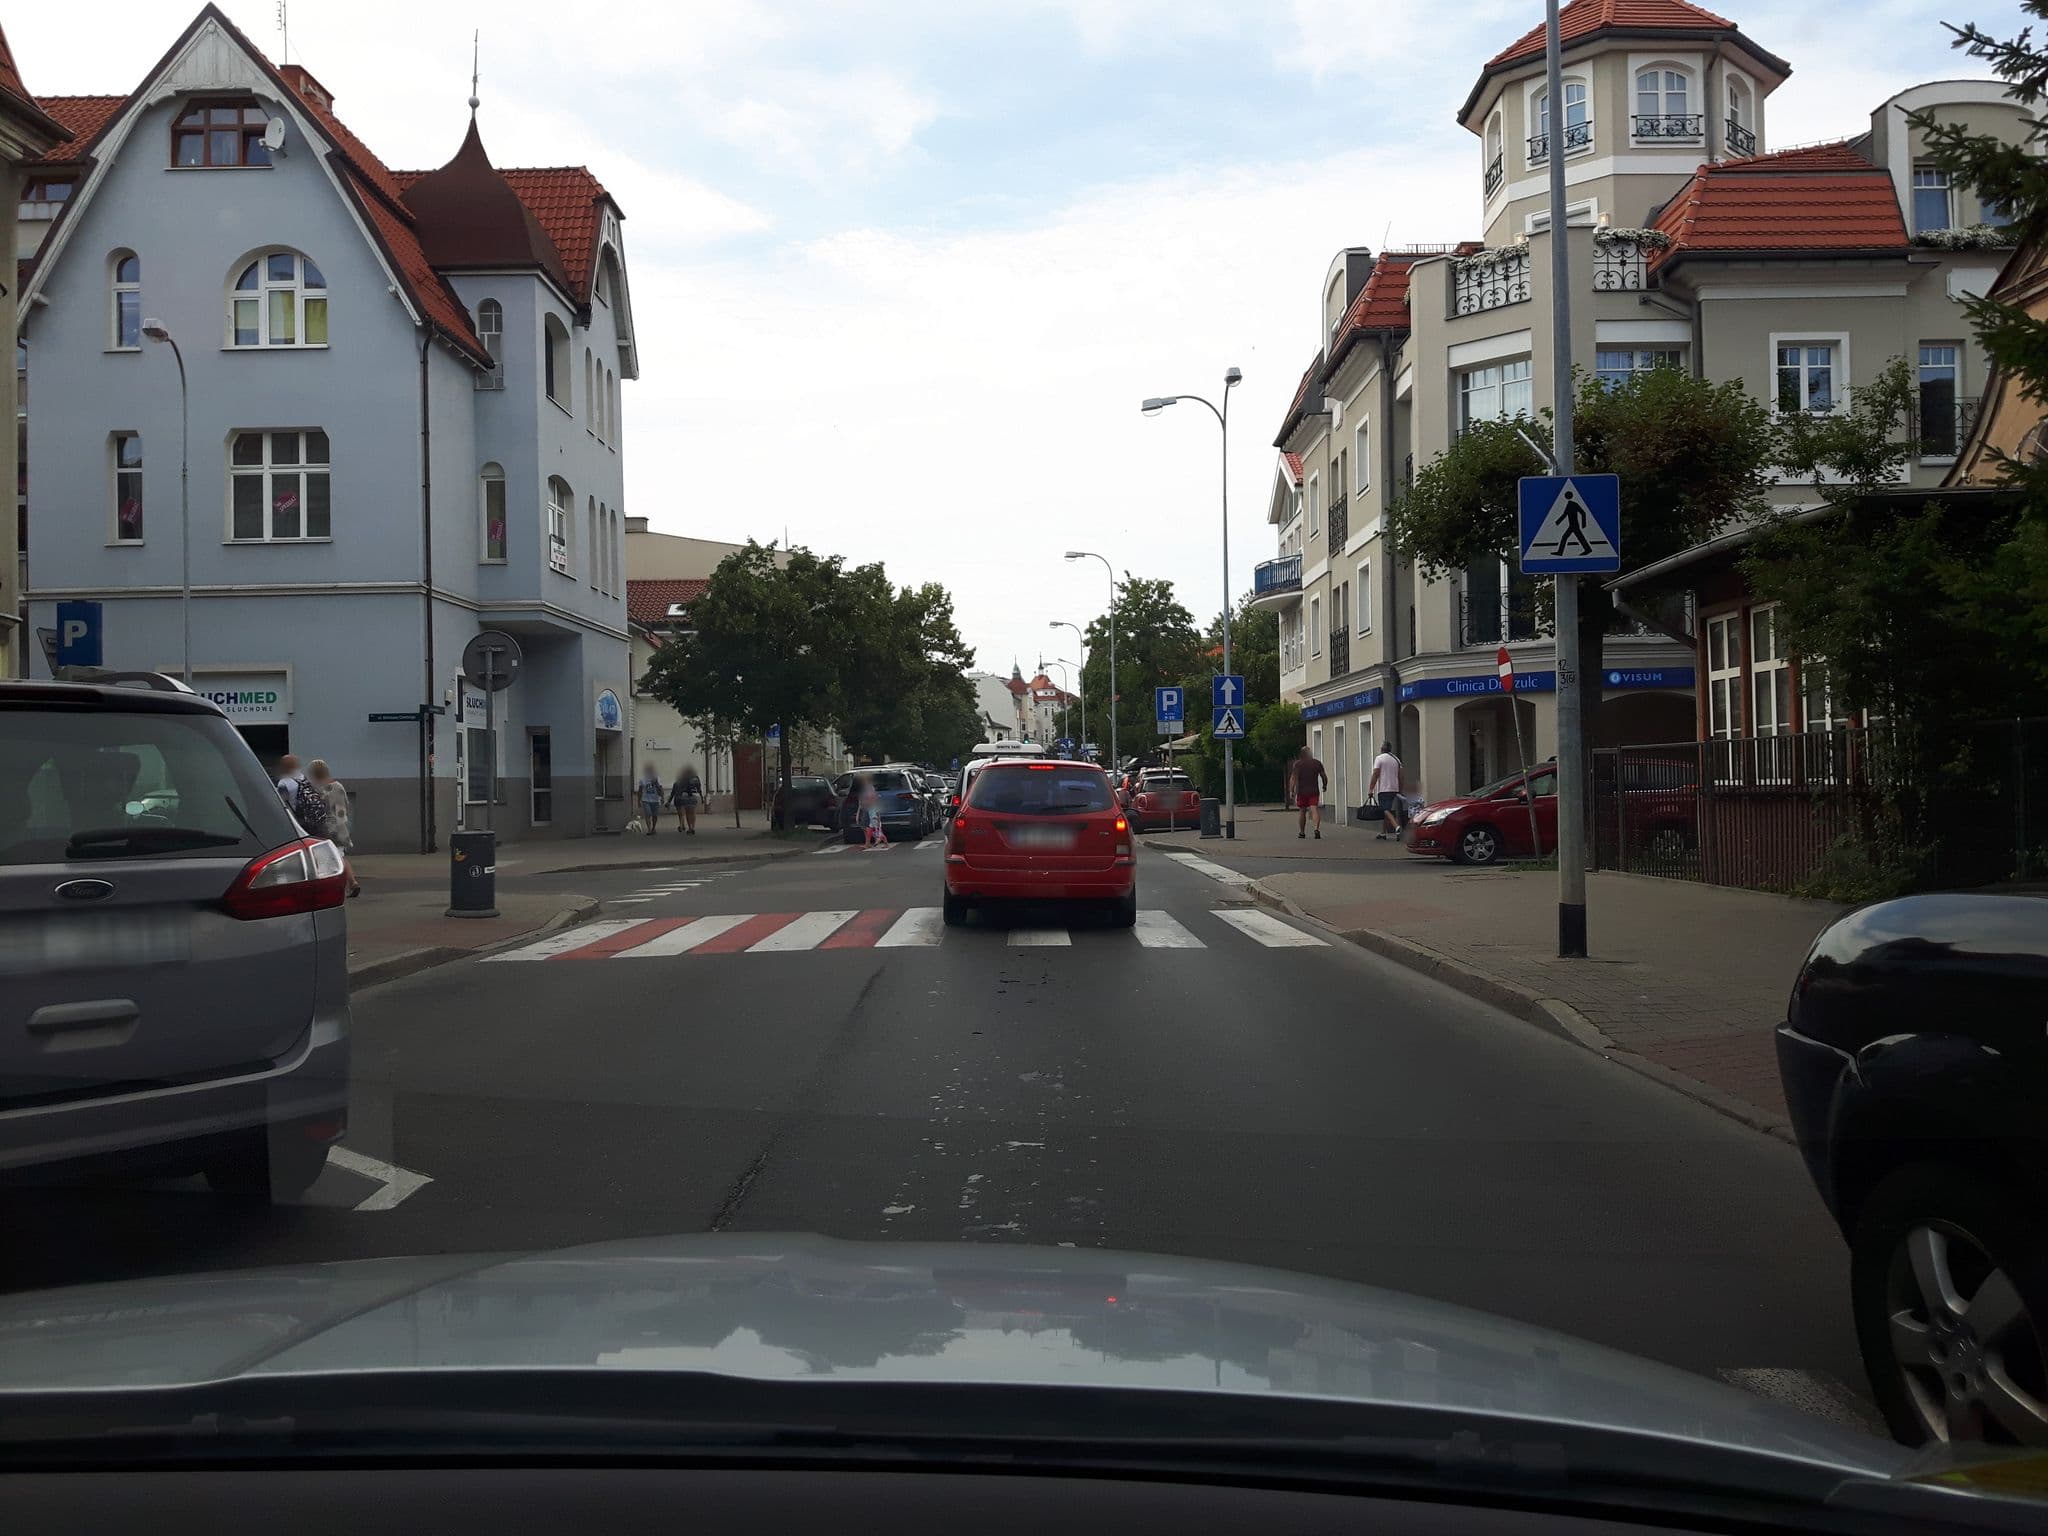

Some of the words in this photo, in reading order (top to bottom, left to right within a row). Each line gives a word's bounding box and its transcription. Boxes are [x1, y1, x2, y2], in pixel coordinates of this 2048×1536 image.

[63, 620, 88, 648] P
[1446, 679, 1486, 693] Clinica
[1514, 675, 1539, 689] zulc
[1623, 672, 1662, 682] VISUM
[1162, 690, 1178, 712] P
